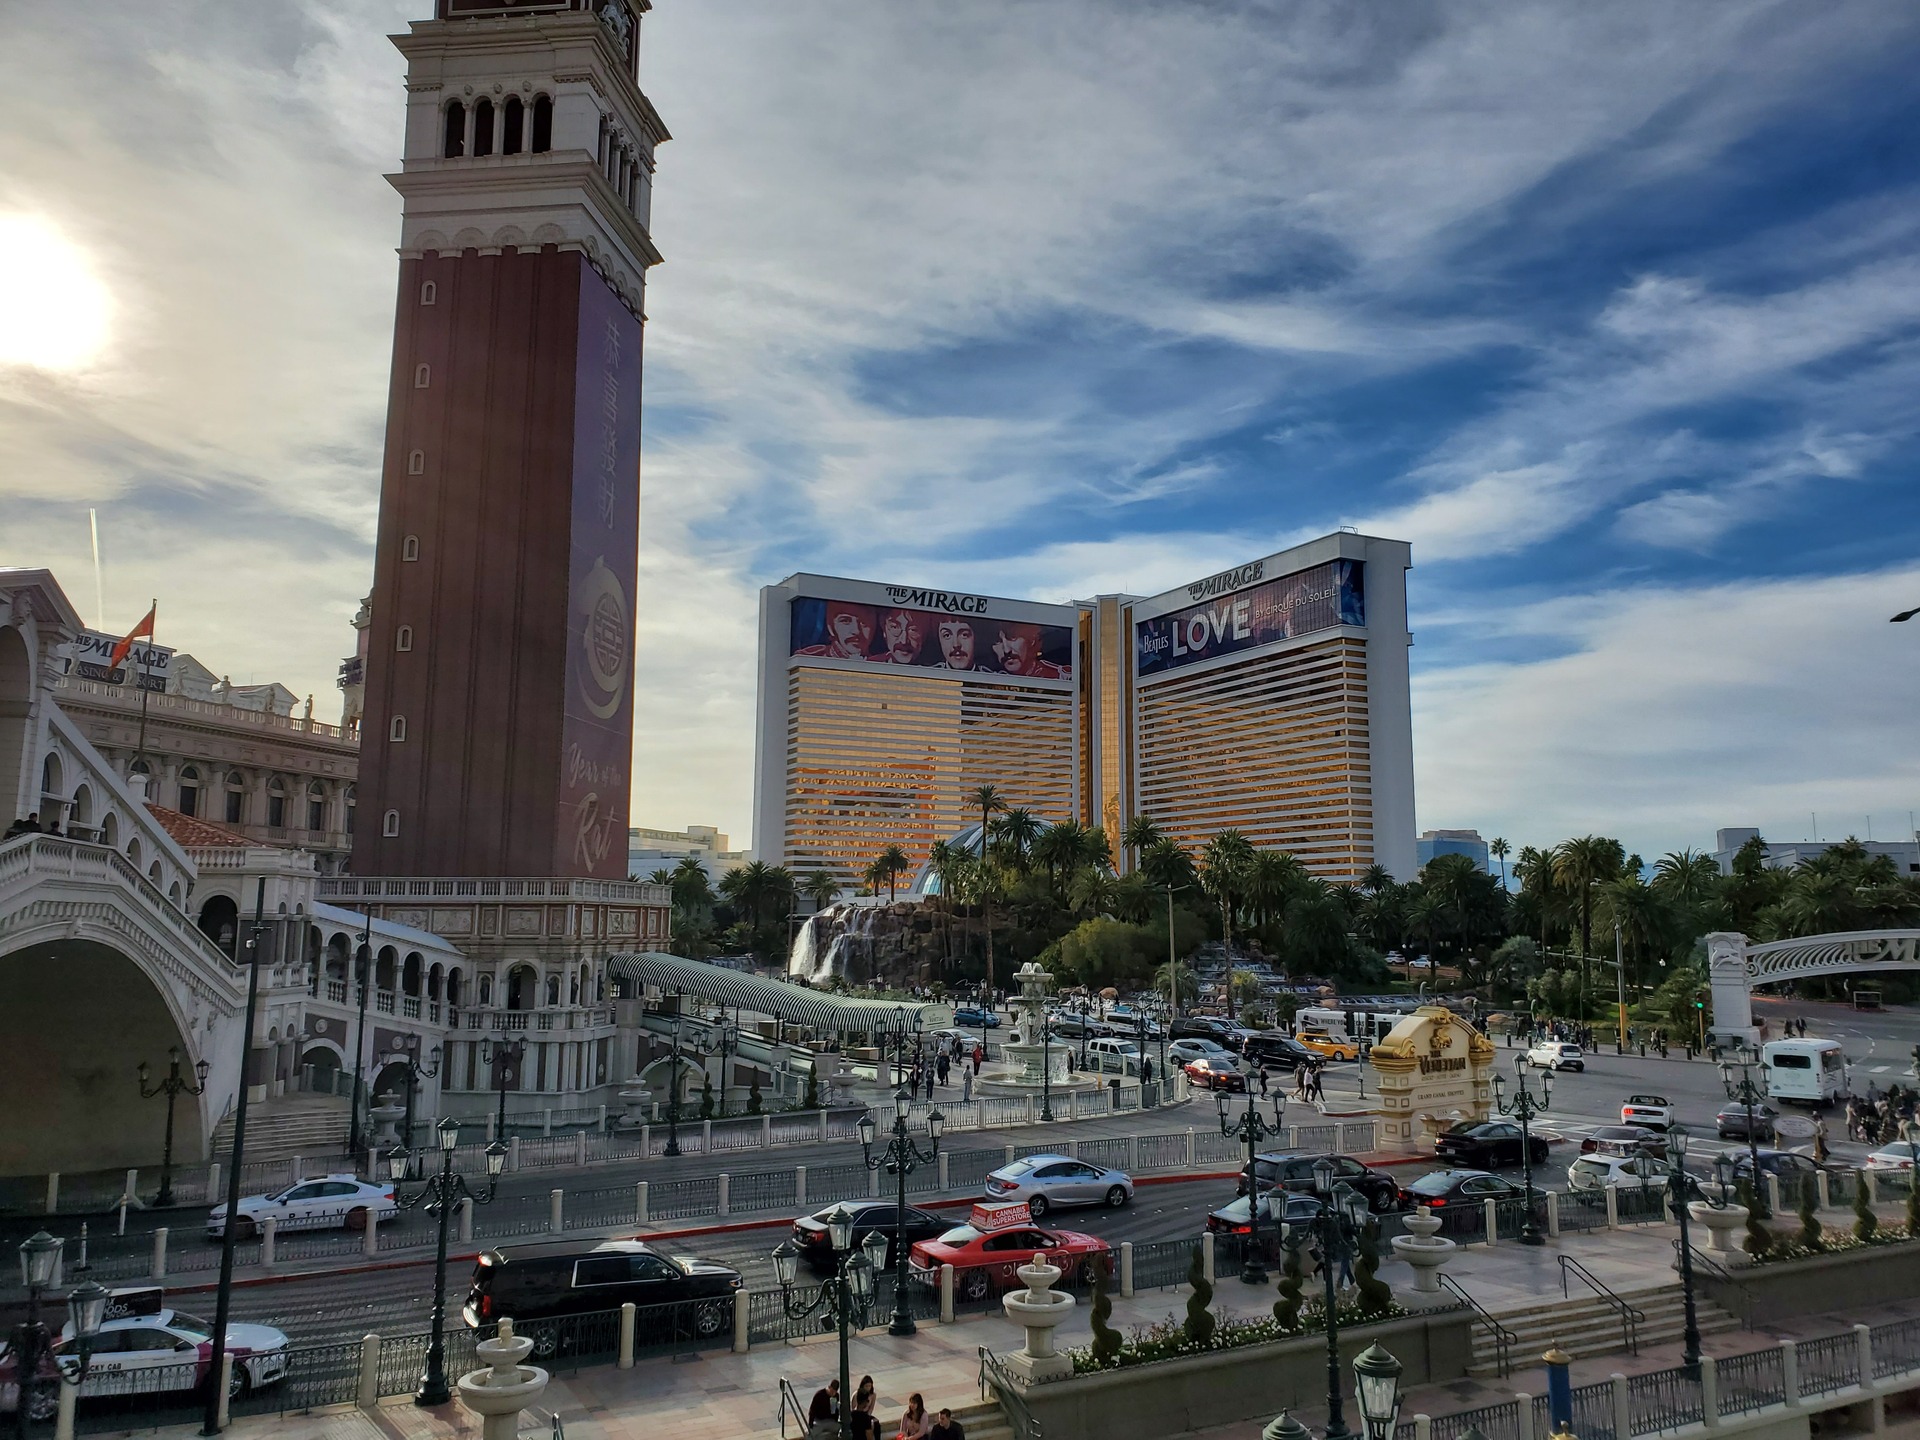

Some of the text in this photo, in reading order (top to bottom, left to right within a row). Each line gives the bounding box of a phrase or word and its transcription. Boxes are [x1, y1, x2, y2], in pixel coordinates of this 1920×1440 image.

[1187, 562, 1263, 601] THE MIRAGE
[886, 587, 988, 613] THE MIRAGE
[1255, 610, 1264, 619] BY
[1266, 600, 1294, 614] CIRQUE
[1295, 597, 1307, 607] DU
[1172, 599, 1251, 658] LOVE
[75, 634, 92, 646] HE
[1143, 635, 1169, 654] BEATLES
[569, 742, 598, 788] Year
[573, 792, 620, 873] Rat
[1417, 1055, 1466, 1075] VENETIAN
[993, 1211, 1031, 1225] SUPERSTORE
[996, 1205, 1026, 1218] CANNABIS
